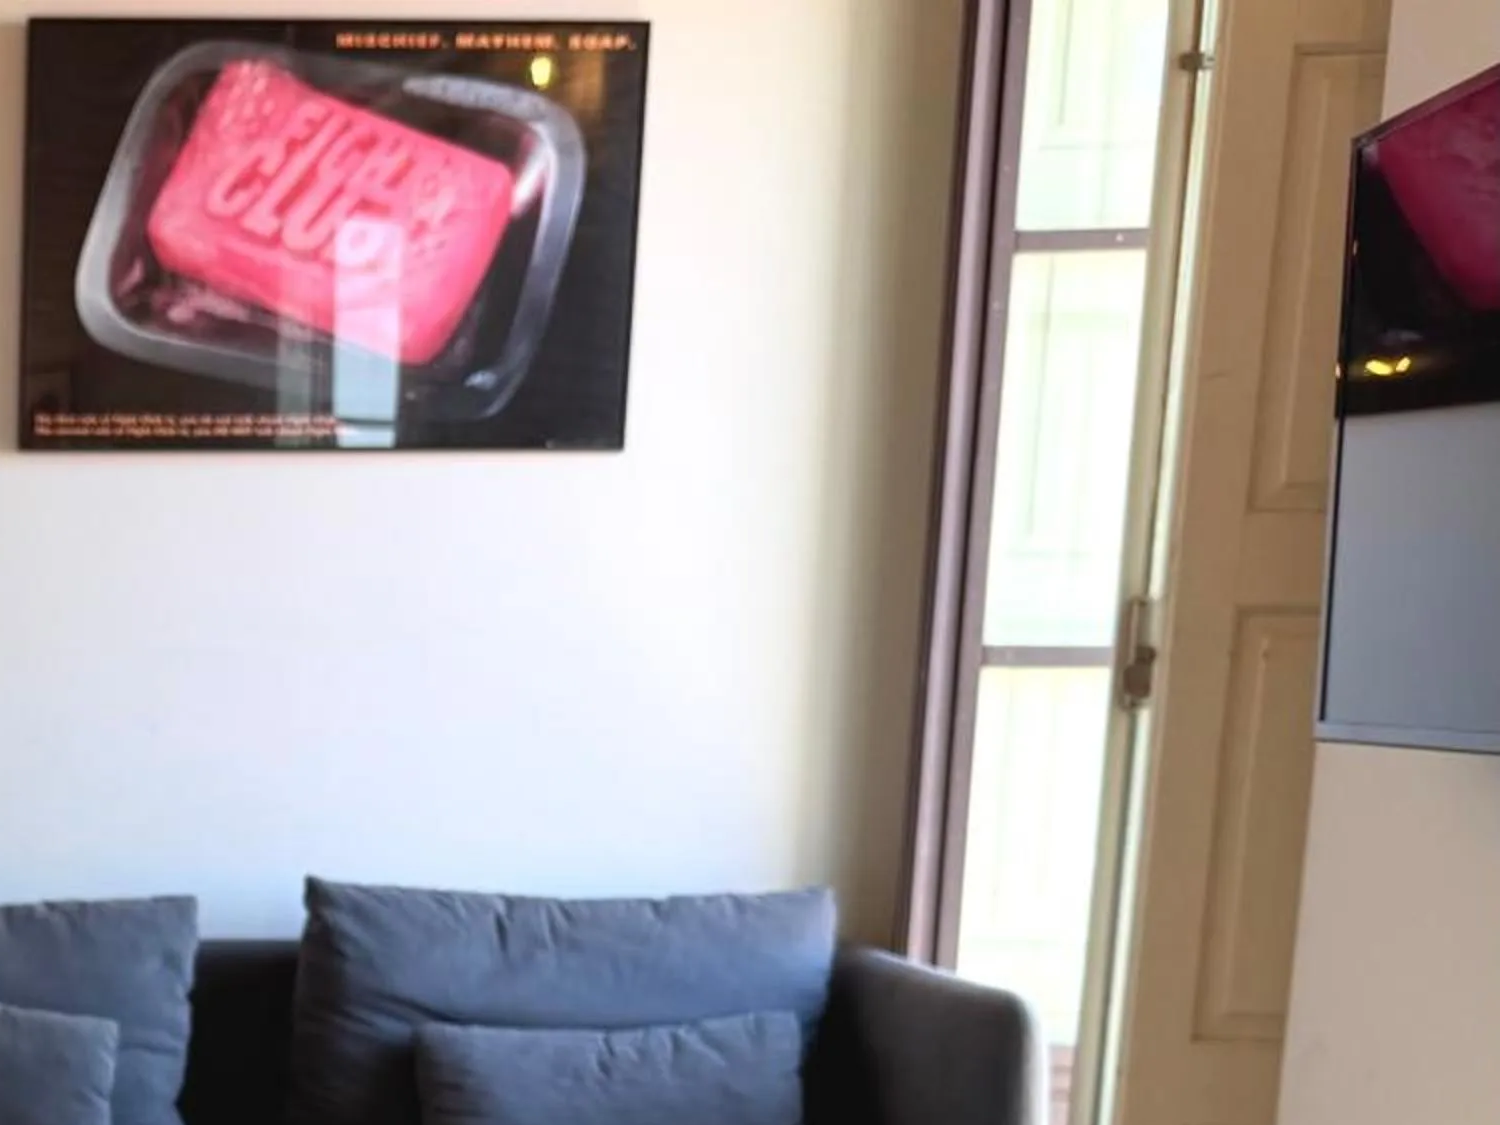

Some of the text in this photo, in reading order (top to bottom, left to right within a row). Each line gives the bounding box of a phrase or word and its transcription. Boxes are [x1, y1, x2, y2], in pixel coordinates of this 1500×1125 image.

[336, 32, 636, 50] MISCHIEF. MAYHEM. SOAP.
